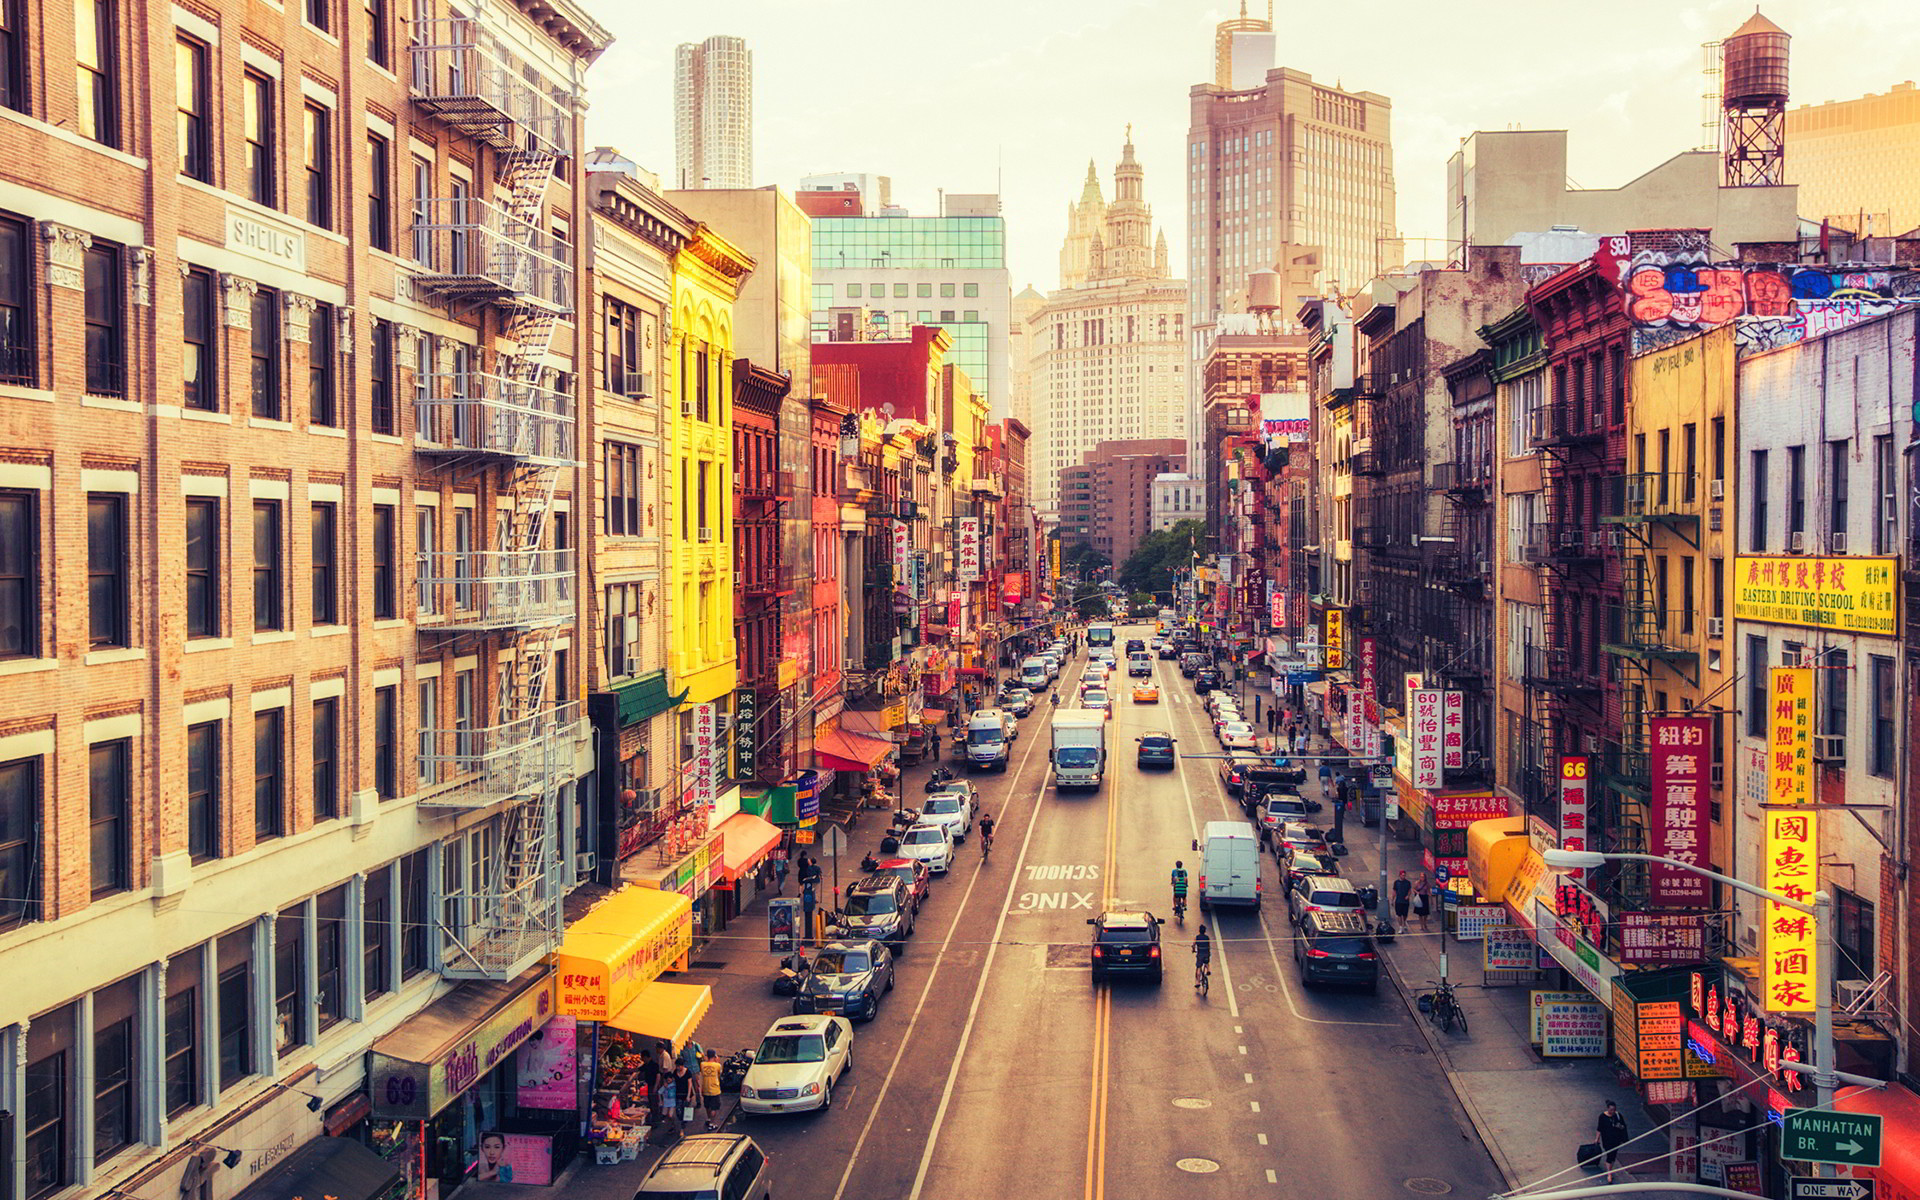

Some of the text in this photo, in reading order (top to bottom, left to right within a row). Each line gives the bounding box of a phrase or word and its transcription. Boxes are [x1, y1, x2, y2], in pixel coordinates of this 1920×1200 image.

[234, 218, 293, 260] SHEILS
[1639, 275, 1659, 288] LES
[1748, 561, 1846, 591] 廣州駕駛學校
[1743, 588, 1855, 610] EASTERN DRIVING SCHOOL
[1658, 726, 1703, 746] 紐約
[1563, 762, 1586, 777] 66
[1025, 865, 1100, 880] SCHOOL
[1018, 892, 1094, 910] XING
[564, 994, 606, 1006] 福州小吃店
[386, 1076, 418, 1105] 69
[1792, 1117, 1872, 1136] MANHATTAN
[1798, 1137, 1819, 1151] BR.
[1803, 1185, 1861, 1197] ONE WAY
